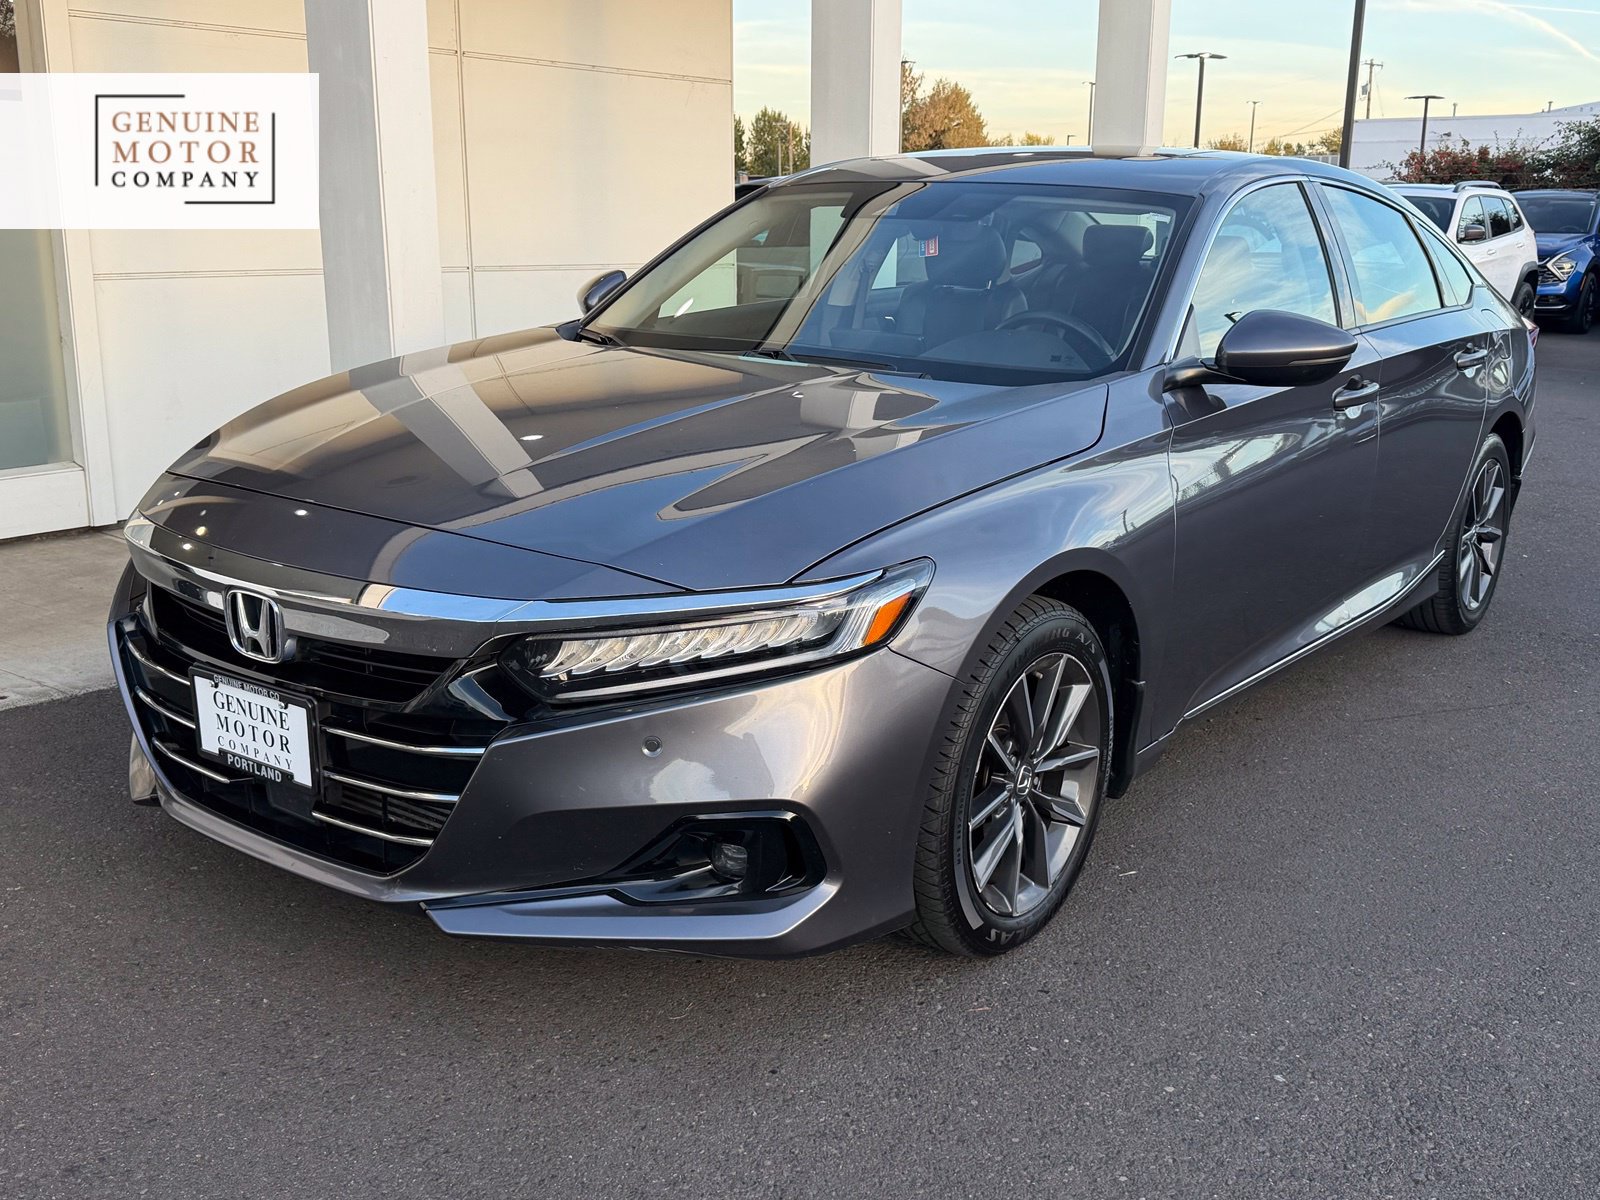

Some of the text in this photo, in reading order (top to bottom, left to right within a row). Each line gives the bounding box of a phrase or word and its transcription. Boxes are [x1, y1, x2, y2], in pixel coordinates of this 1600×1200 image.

[213, 674, 243, 689] GENUINE
[243, 682, 269, 697] MOTOR
[213, 690, 290, 731] GENUINE
[216, 713, 291, 754] MOTOR
[217, 735, 292, 771] COMPANY
[227, 753, 282, 783] PORTLAND
